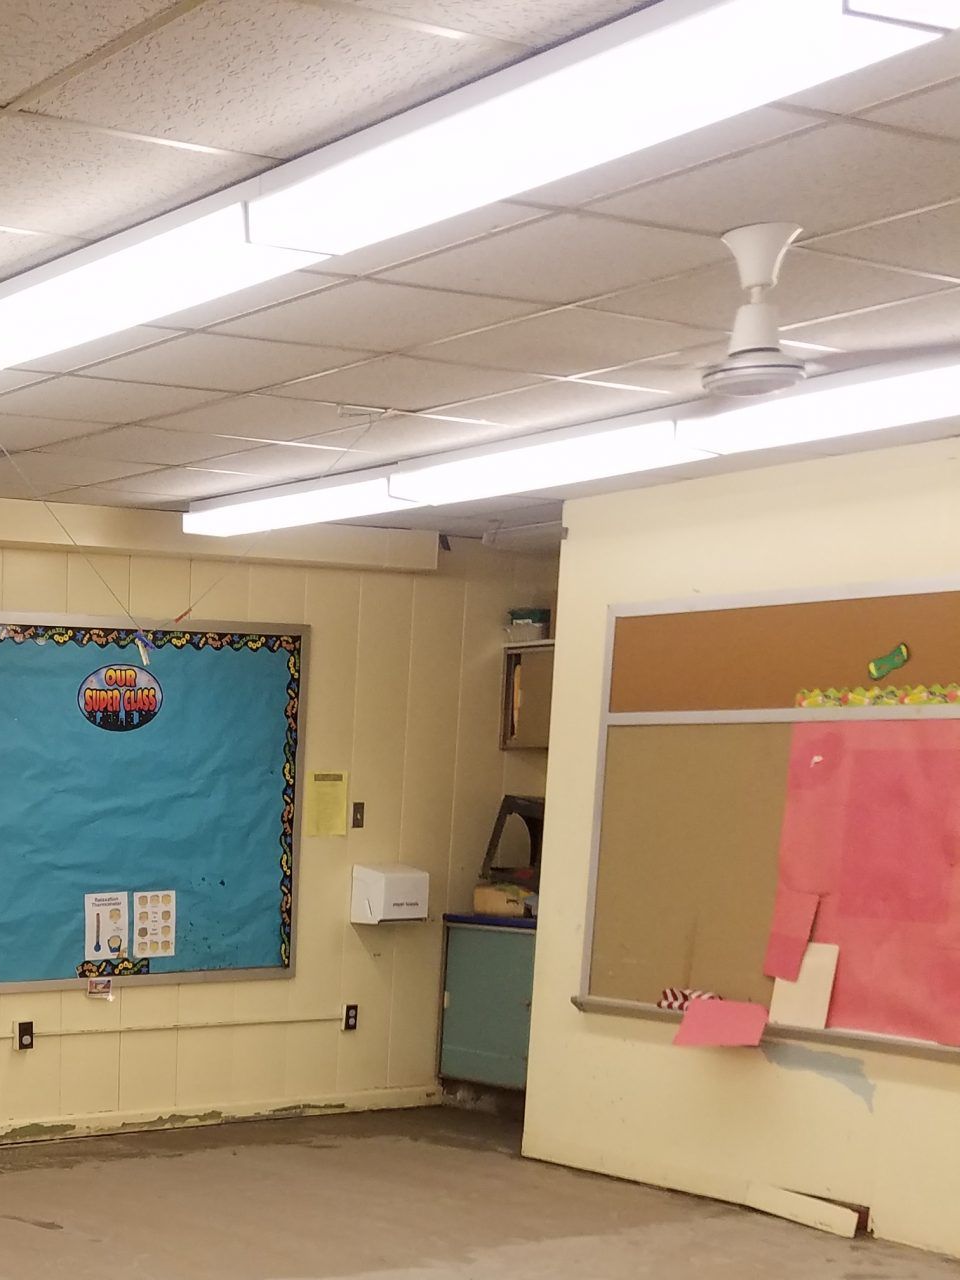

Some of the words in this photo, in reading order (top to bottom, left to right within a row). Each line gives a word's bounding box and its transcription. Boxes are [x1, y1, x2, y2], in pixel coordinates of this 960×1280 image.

[105, 668, 137, 688] OUR
[84, 687, 121, 713] SUPER
[123, 687, 157, 713] CLASS
